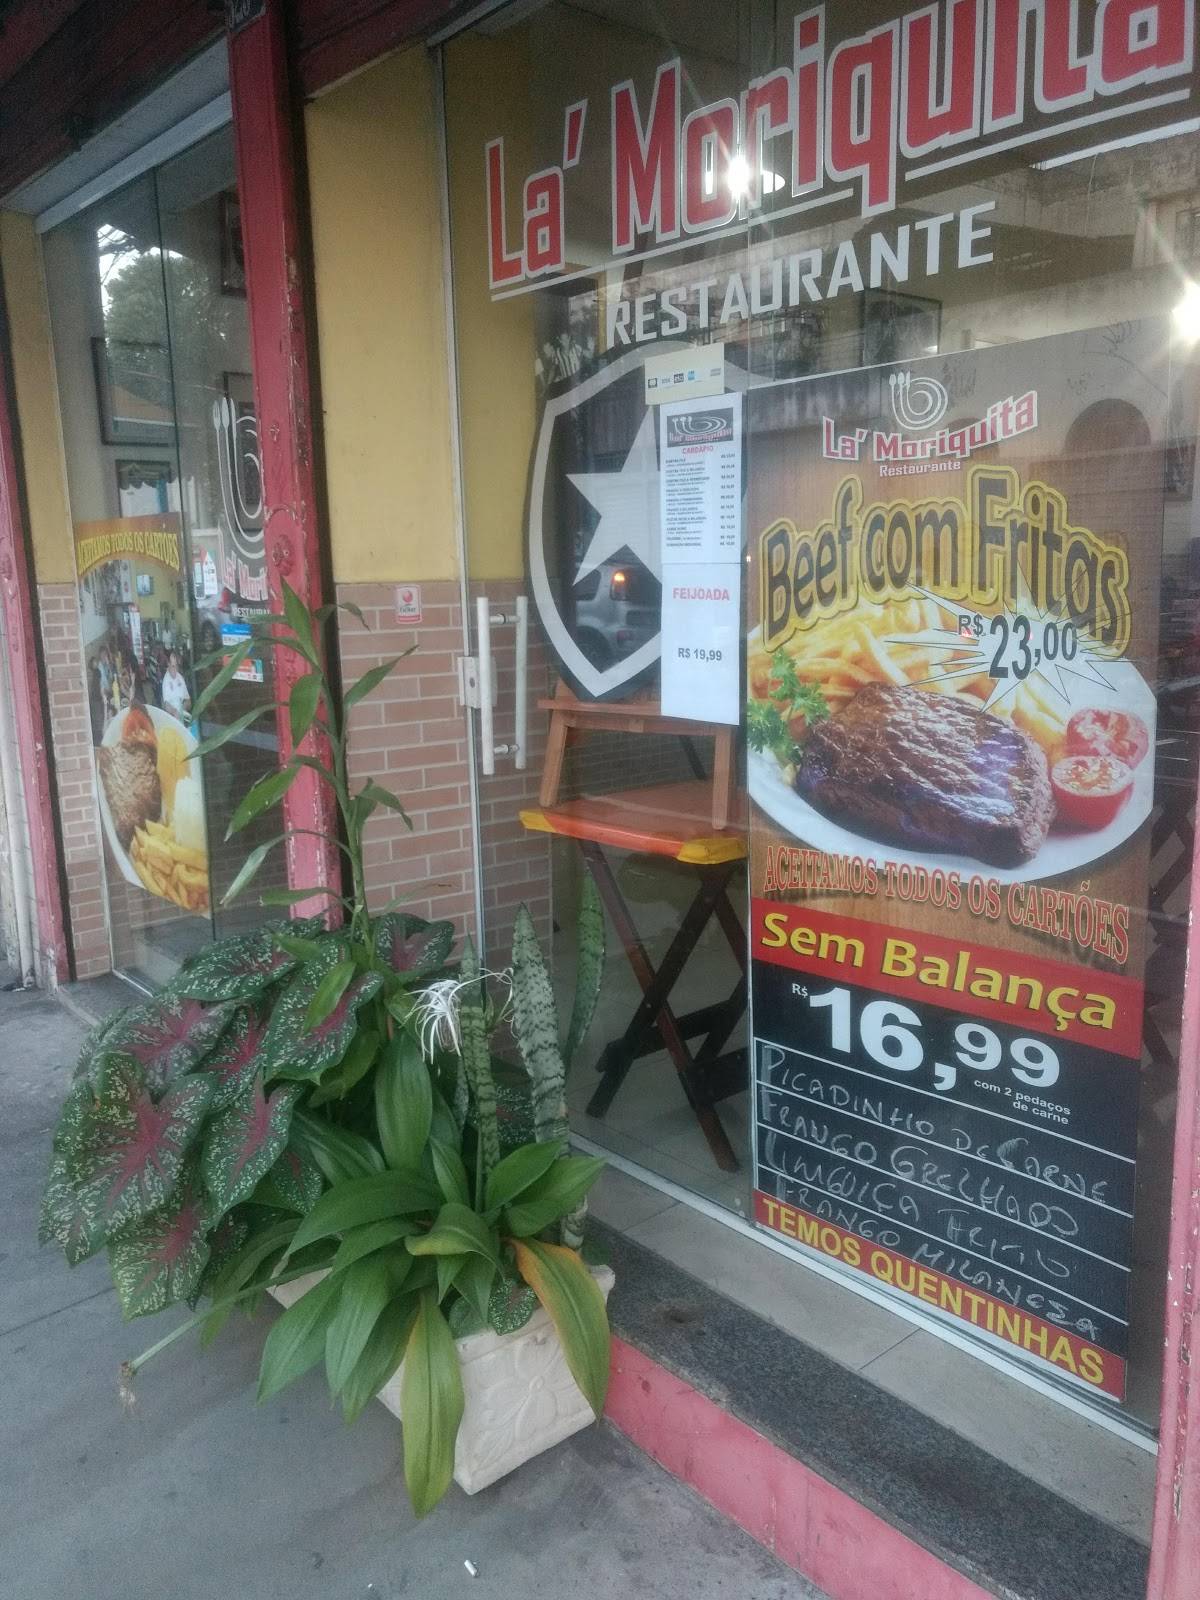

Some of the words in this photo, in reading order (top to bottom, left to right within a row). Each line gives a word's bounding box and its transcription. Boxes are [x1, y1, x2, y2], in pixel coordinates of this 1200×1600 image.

[485, 99, 588, 289] La'
[606, 201, 996, 349] RESTAURANTE
[823, 416, 869, 460] La'
[872, 390, 1038, 462] Moriquita
[879, 460, 962, 478] Restaurante
[672, 587, 730, 601] FEIJOADA
[763, 478, 861, 648] Beef
[864, 501, 965, 598] com
[971, 469, 1129, 653] Fritas
[678, 647, 691, 659] R$
[694, 648, 722, 662] 19,99
[958, 614, 984, 637] R$
[989, 614, 1078, 681] 23,00
[764, 846, 879, 895] ACEITAMOS
[884, 861, 961, 909] TODOS
[967, 874, 1001, 919] OS
[1007, 880, 1129, 965] CARTÕES
[761, 912, 865, 968] Sem
[881, 938, 1116, 1032] Balança
[791, 983, 809, 998] R$
[809, 987, 1060, 1091] 16,99
[760, 1088, 878, 1165] FRANGO
[761, 1045, 935, 1136] PICADINHO
[974, 1079, 1000, 1094] com
[1004, 1087, 1013, 1097] 2
[1015, 1091, 1071, 1116] pedaços
[1012, 1100, 1029, 1112] de
[1032, 1106, 1069, 1126] carne
[776, 1173, 901, 1247] FRANGO
[763, 1199, 862, 1267] TEMOS
[870, 1250, 1105, 1385] QUENTINHAS
